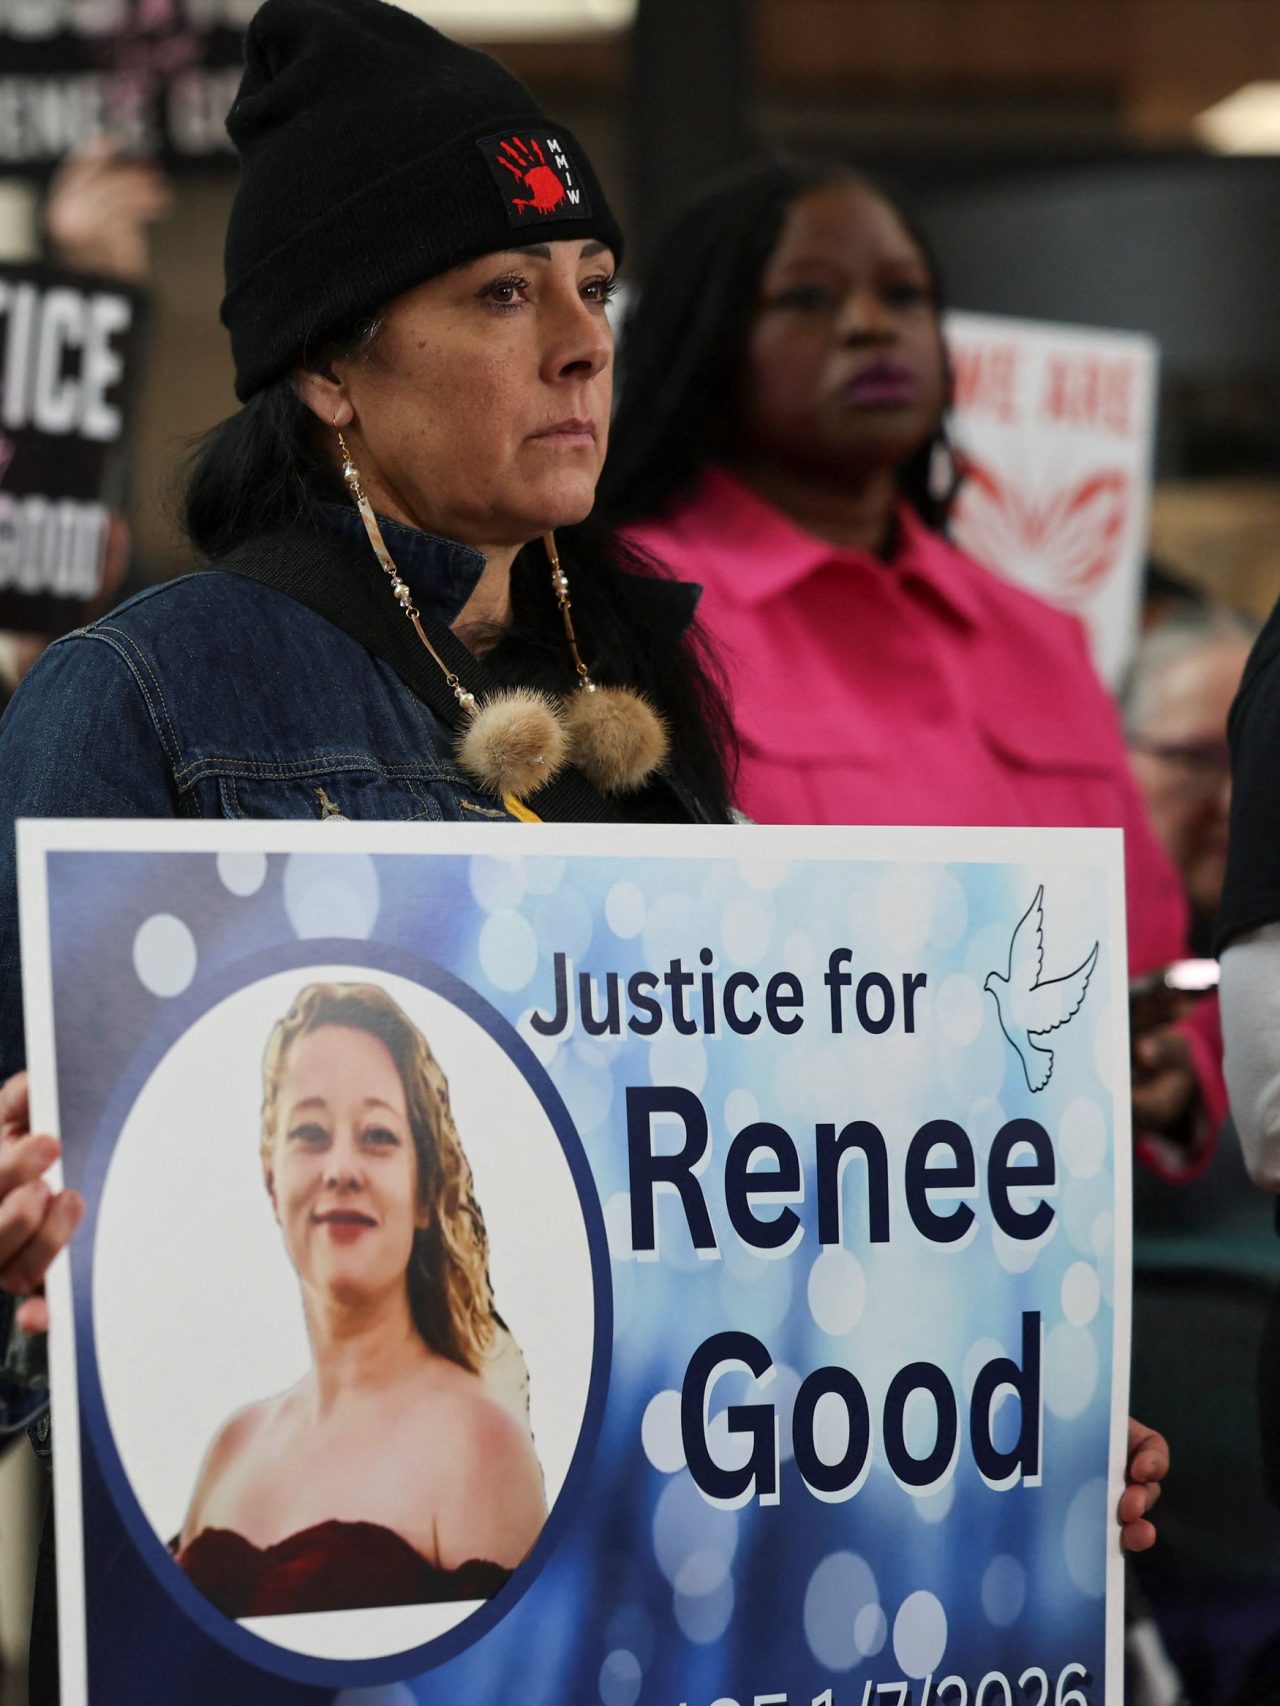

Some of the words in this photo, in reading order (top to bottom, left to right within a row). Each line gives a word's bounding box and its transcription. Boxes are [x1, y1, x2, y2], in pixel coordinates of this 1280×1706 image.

[546, 138, 580, 205] MMIW
[529, 946, 805, 1037] Justice
[824, 948, 927, 1035] for
[625, 1085, 1056, 1251] Renee
[680, 1310, 1042, 1500] Good
